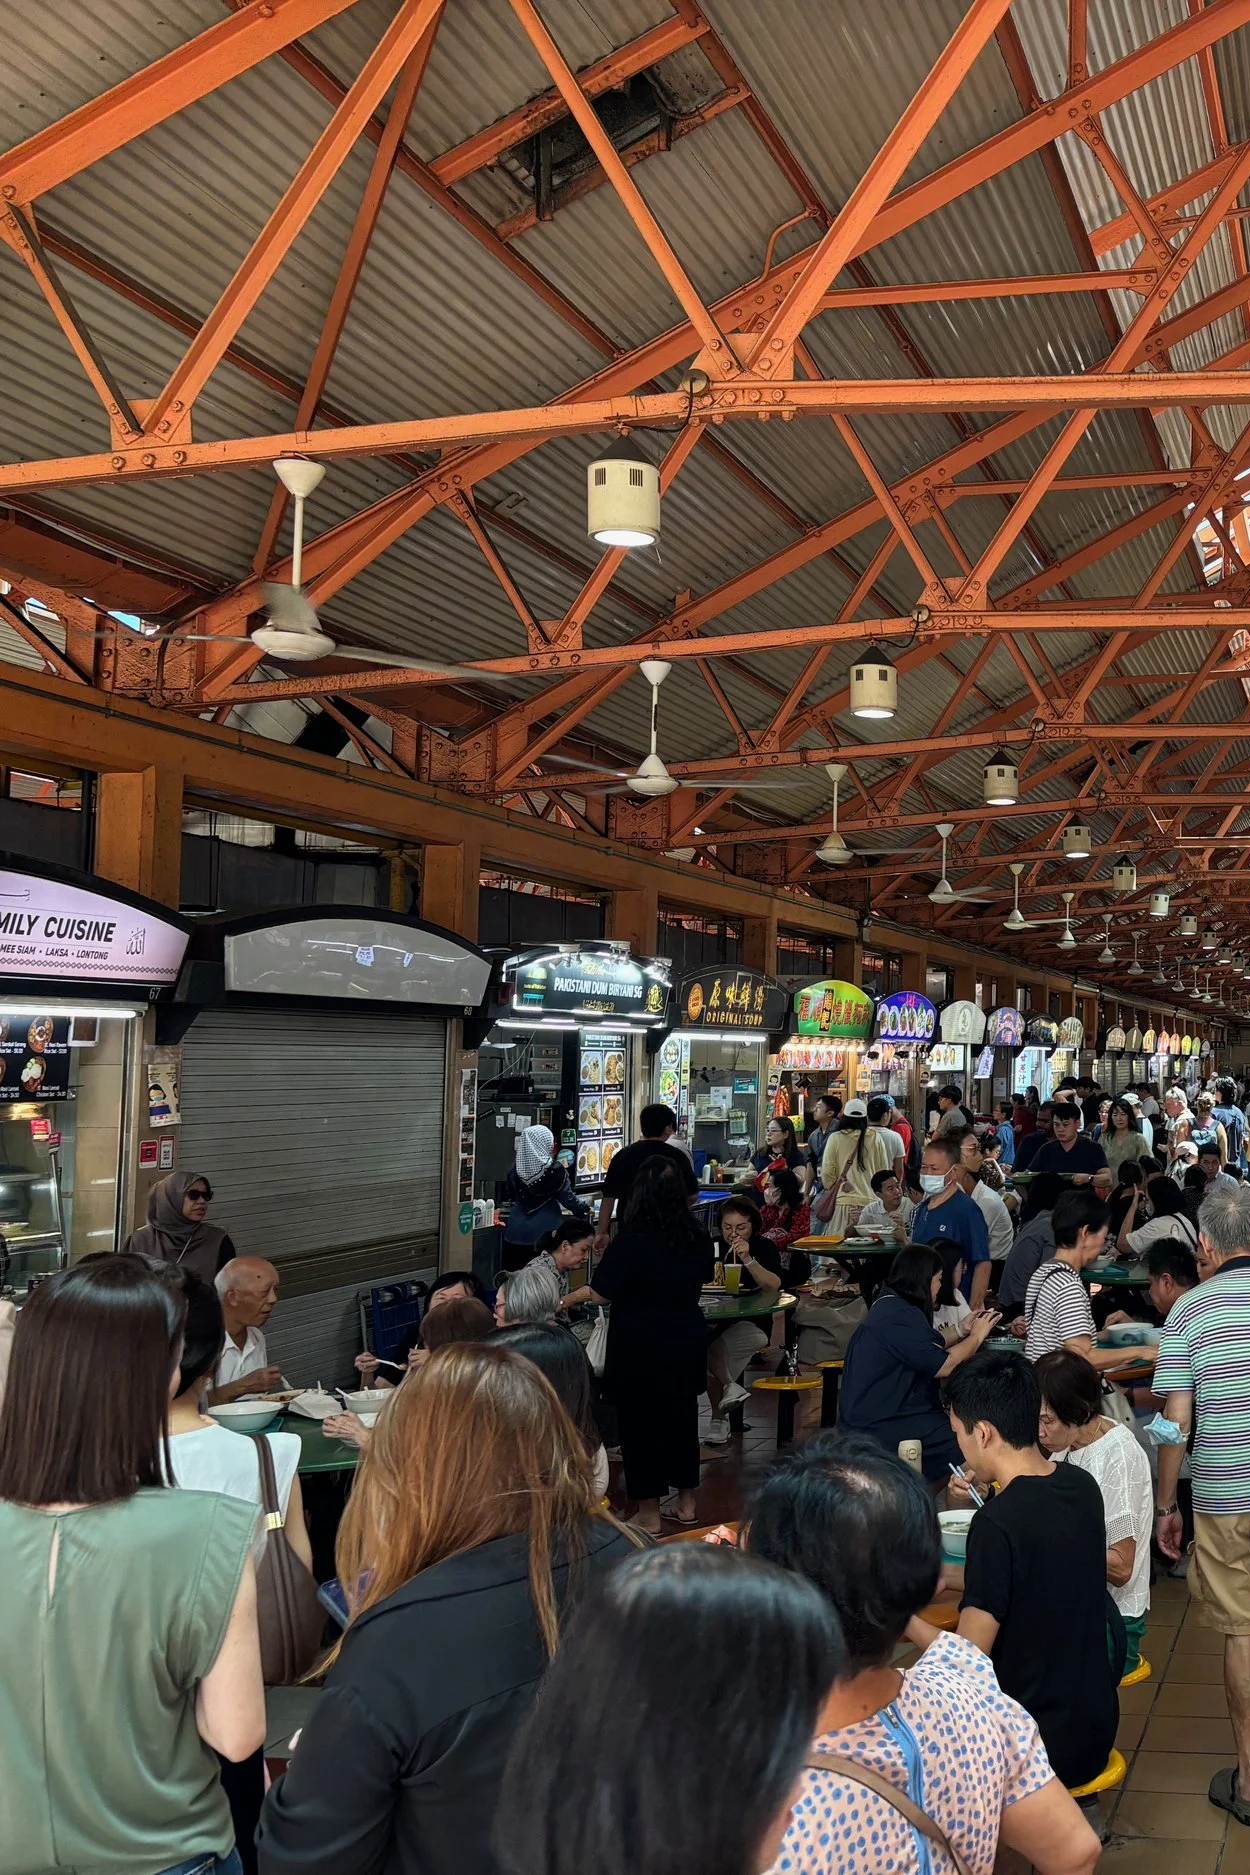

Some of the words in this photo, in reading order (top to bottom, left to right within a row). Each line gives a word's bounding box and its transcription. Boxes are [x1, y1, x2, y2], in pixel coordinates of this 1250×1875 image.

[43, 916, 117, 943] CUISINE
[1, 943, 17, 954] MEE
[16, 945, 37, 956] SIAM
[45, 947, 69, 958] LAKSA
[76, 949, 109, 961] LONTONG
[150, 987, 162, 1000] 67
[553, 976, 591, 996] PAKISTANI
[591, 980, 608, 996] DUM
[609, 982, 634, 999] BIRYANI
[633, 985, 643, 999] SG
[706, 1011, 742, 1026] ORIGINAL
[744, 1014, 763, 1026] SOUP
